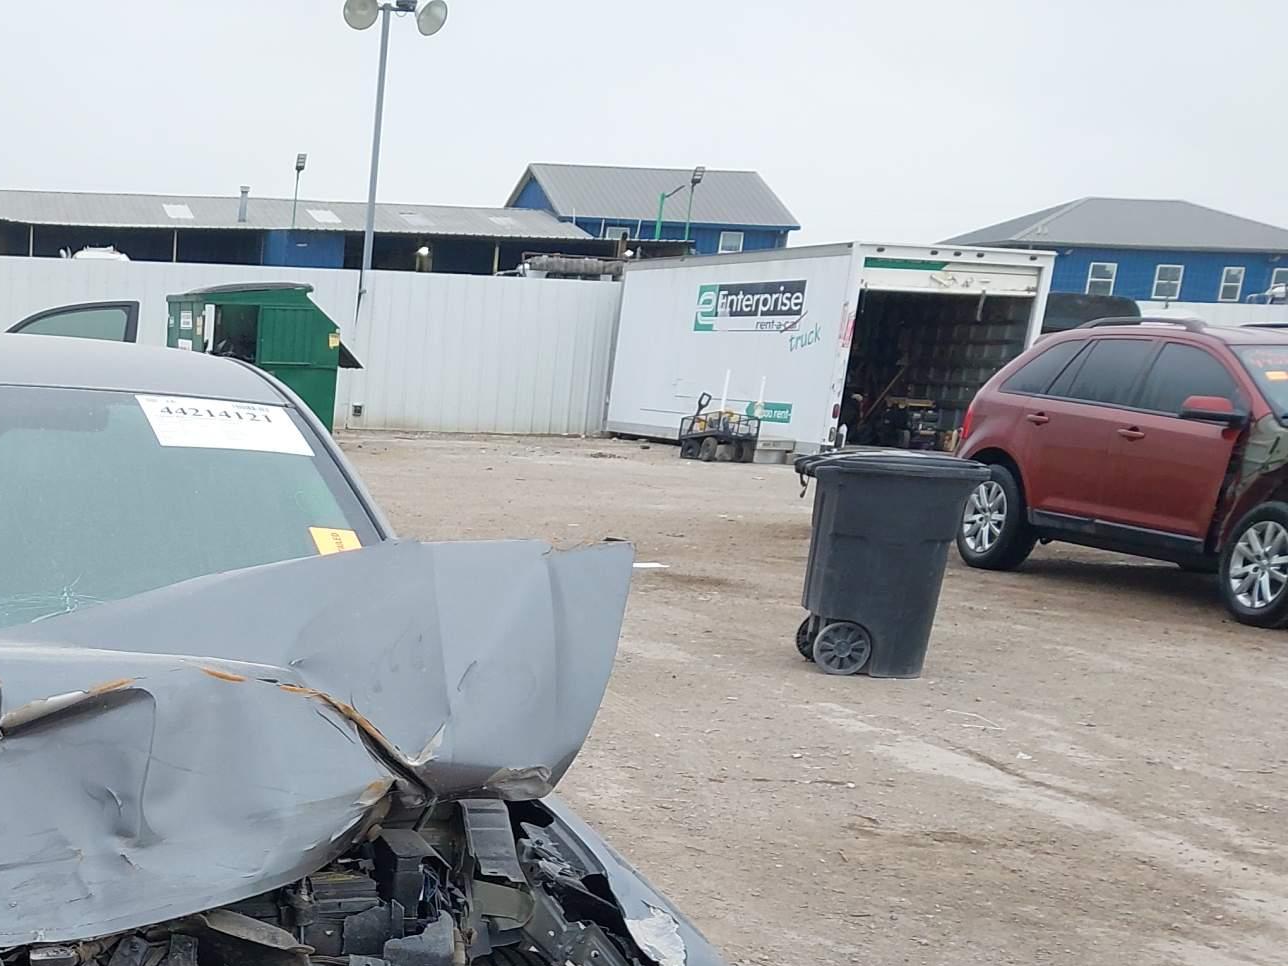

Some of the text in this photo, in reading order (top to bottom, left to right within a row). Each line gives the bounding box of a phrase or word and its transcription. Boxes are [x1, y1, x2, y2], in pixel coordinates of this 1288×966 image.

[717, 285, 803, 316] Enterprise
[788, 323, 822, 352] truck
[160, 405, 273, 423] 44214121
